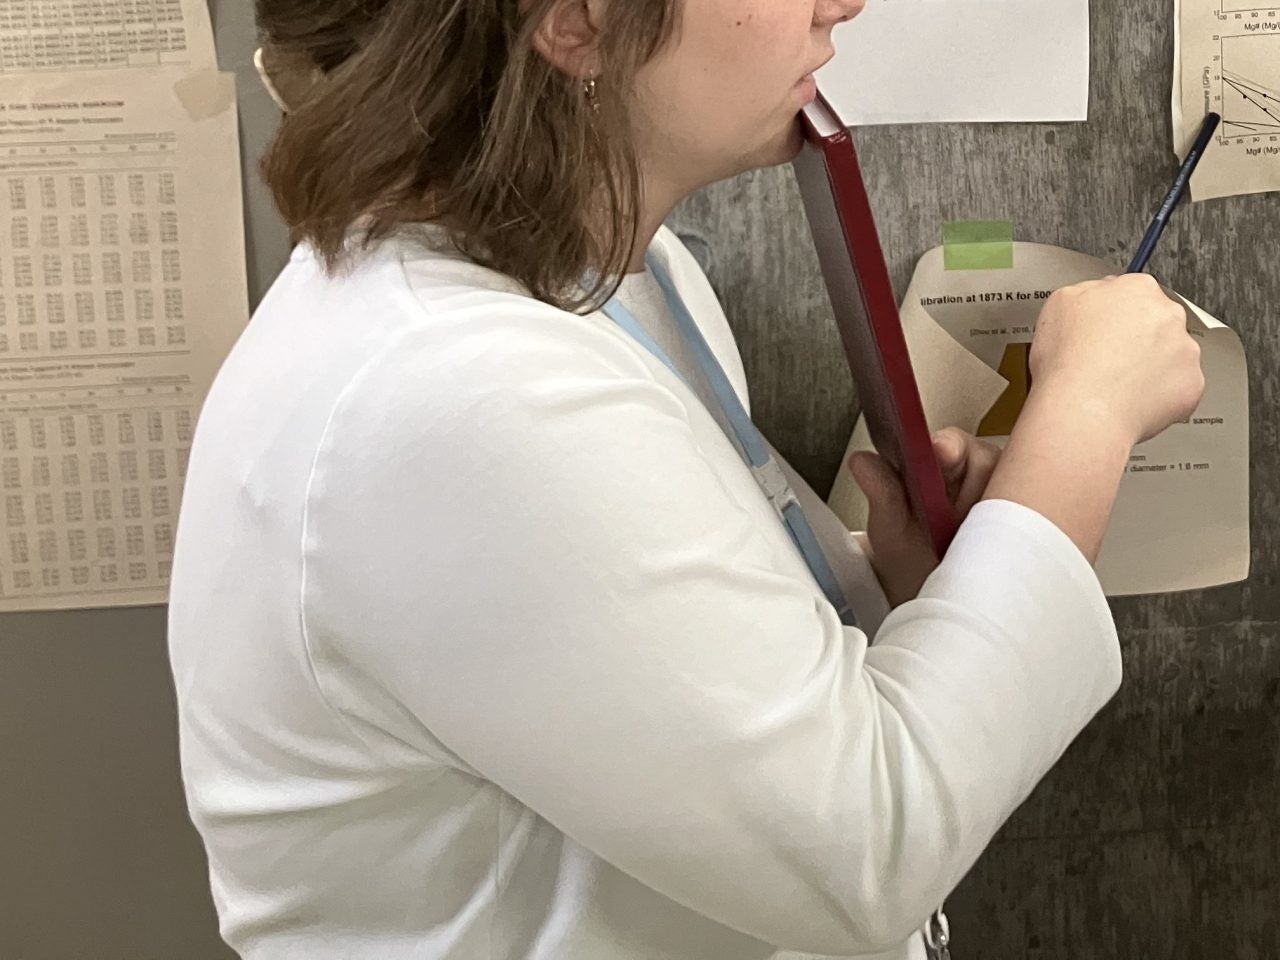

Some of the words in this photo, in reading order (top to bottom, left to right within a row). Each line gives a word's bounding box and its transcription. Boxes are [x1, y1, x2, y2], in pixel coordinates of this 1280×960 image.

[966, 294, 976, 303] at
[978, 292, 1003, 302] 1873
[1005, 292, 1014, 301] K
[1016, 291, 1032, 300] for
[1193, 417, 1224, 425] sample
[1130, 463, 1167, 473] diameter
